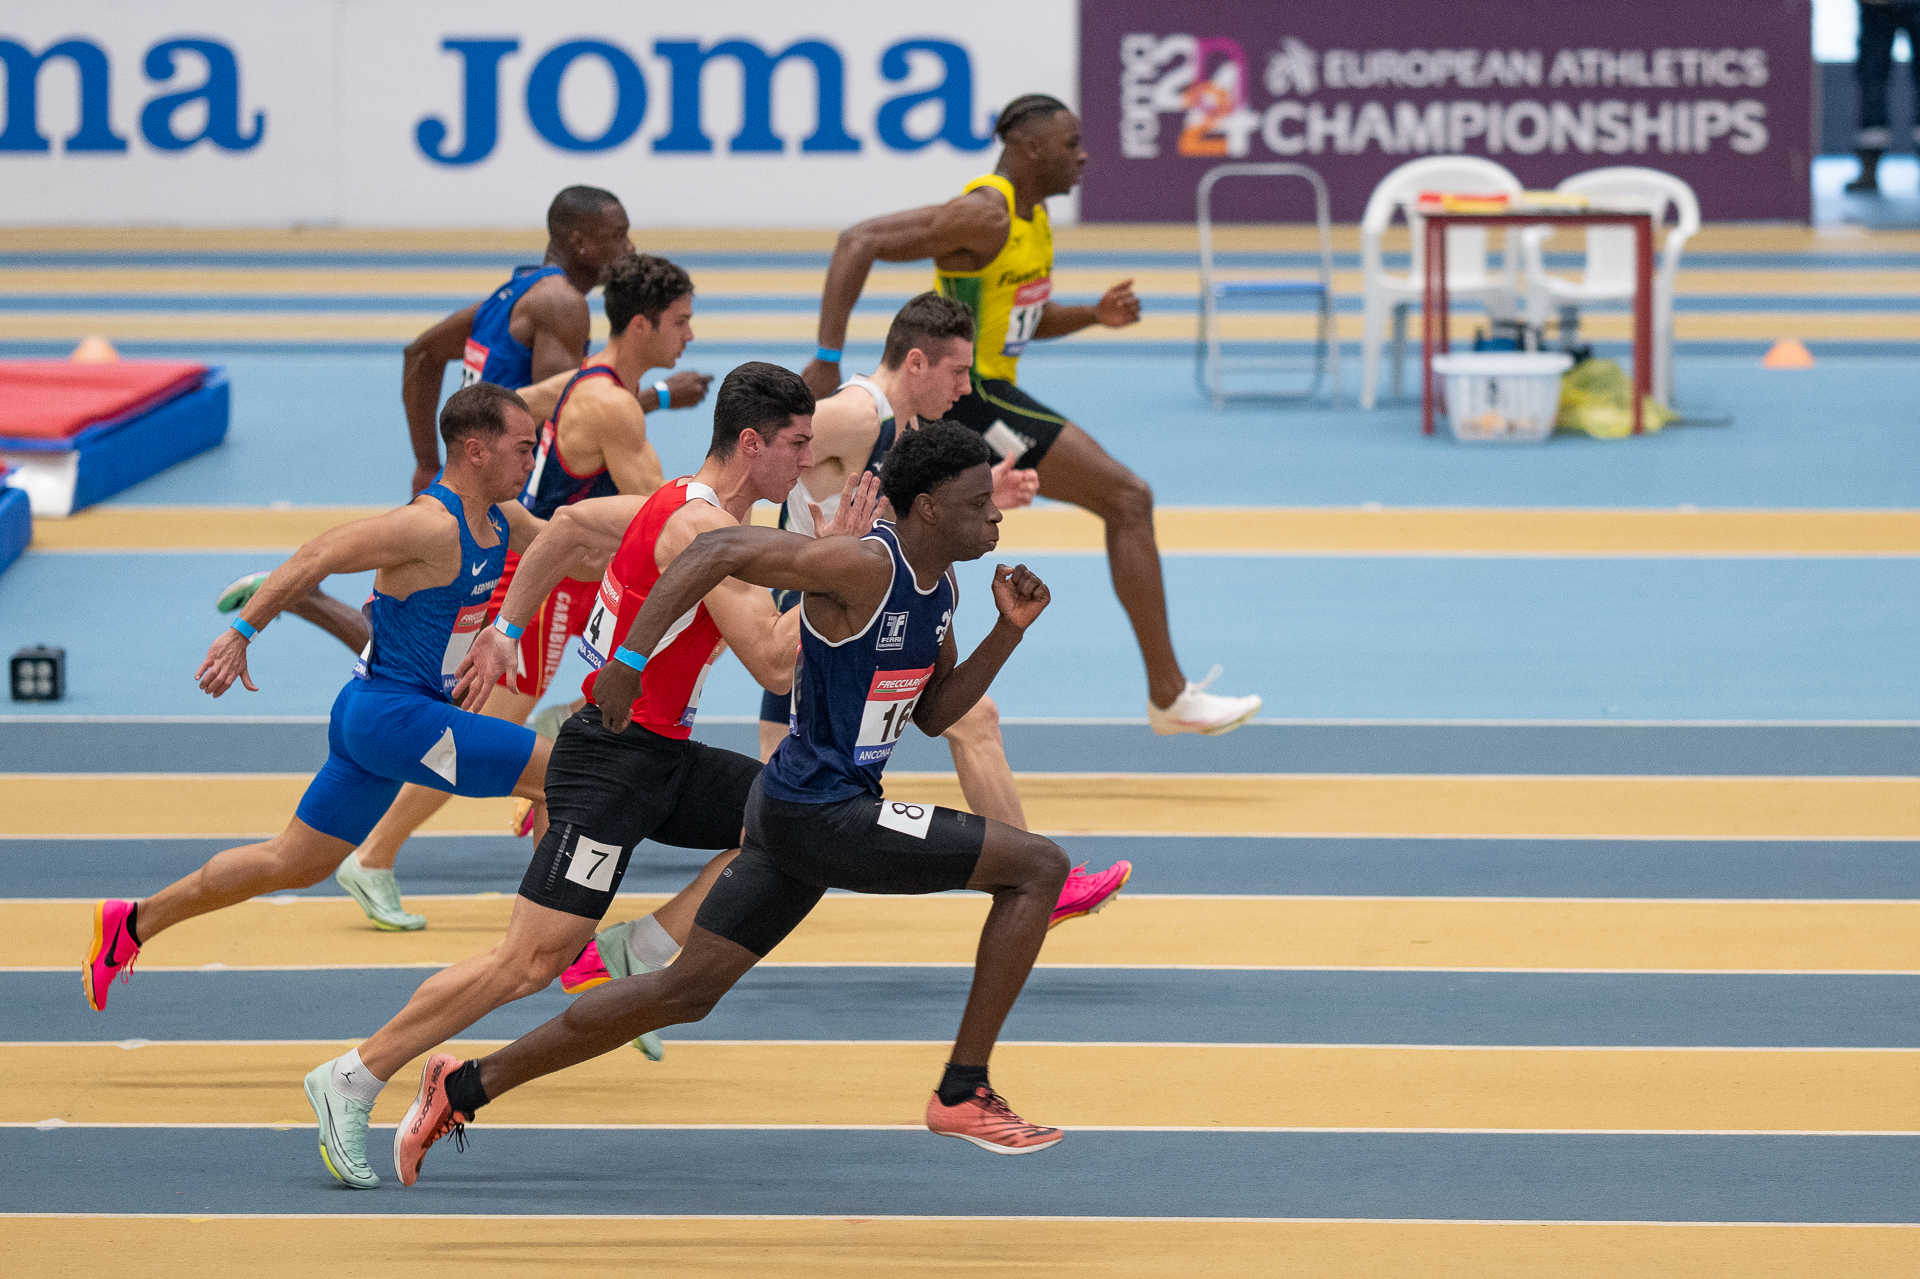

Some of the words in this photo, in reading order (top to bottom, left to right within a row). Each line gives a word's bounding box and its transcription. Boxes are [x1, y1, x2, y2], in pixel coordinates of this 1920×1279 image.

[1324, 49, 1542, 88] EUROPEAN
[1545, 49, 1768, 89] ATHLETICS
[1261, 101, 1769, 155] CHAMPIONSHIPS
[586, 649, 602, 669] 2024
[880, 700, 915, 743] 16
[858, 748, 891, 761] ANCONA
[891, 802, 925, 820] 8
[586, 848, 610, 880] 7
